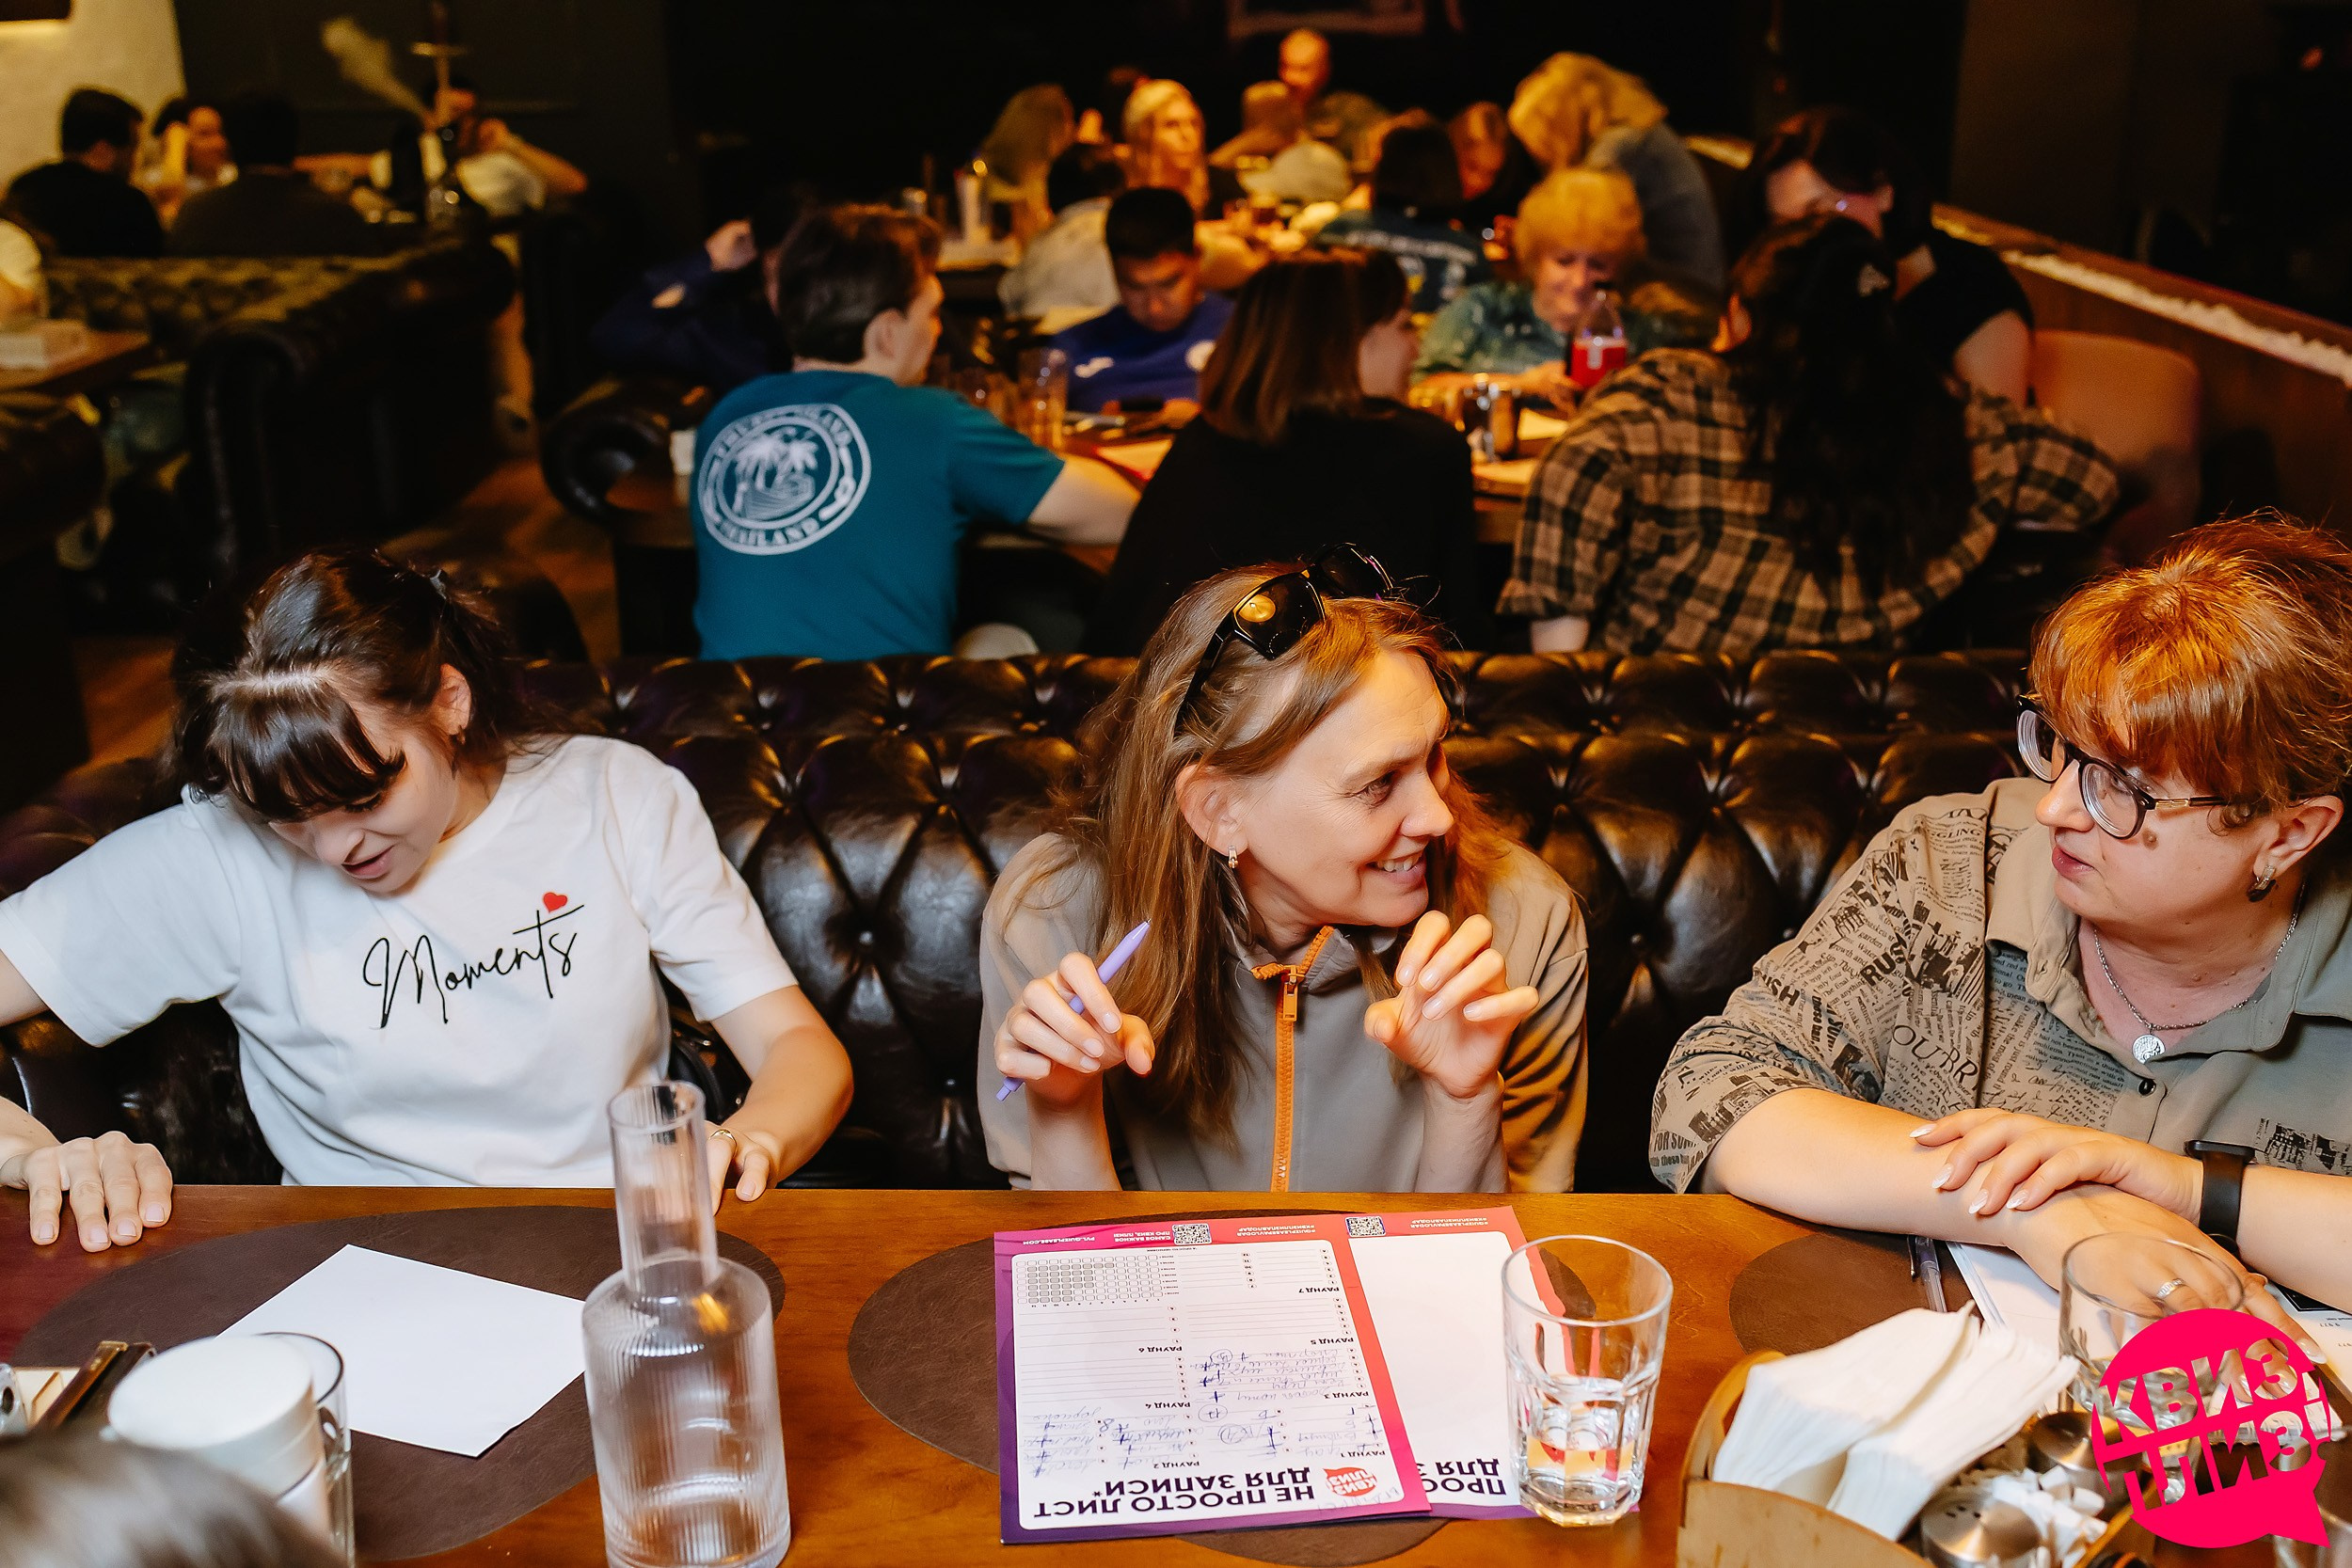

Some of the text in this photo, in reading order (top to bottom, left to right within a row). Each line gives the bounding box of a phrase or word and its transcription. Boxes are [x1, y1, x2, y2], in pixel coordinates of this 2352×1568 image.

[363, 905, 584, 1028] Moments
[2003, 1033, 2015, 1044] the
[1997, 1062, 2012, 1084] round
[1653, 1131, 1670, 1152] FOR
[1244, 1466, 1311, 1488] ДЛЯ
[1435, 1458, 1500, 1477] ДЛЯ
[1129, 1489, 1266, 1513] ПРОСТО
[1276, 1484, 1315, 1503] НЕ
[1032, 1497, 1121, 1518] ЛИСТ
